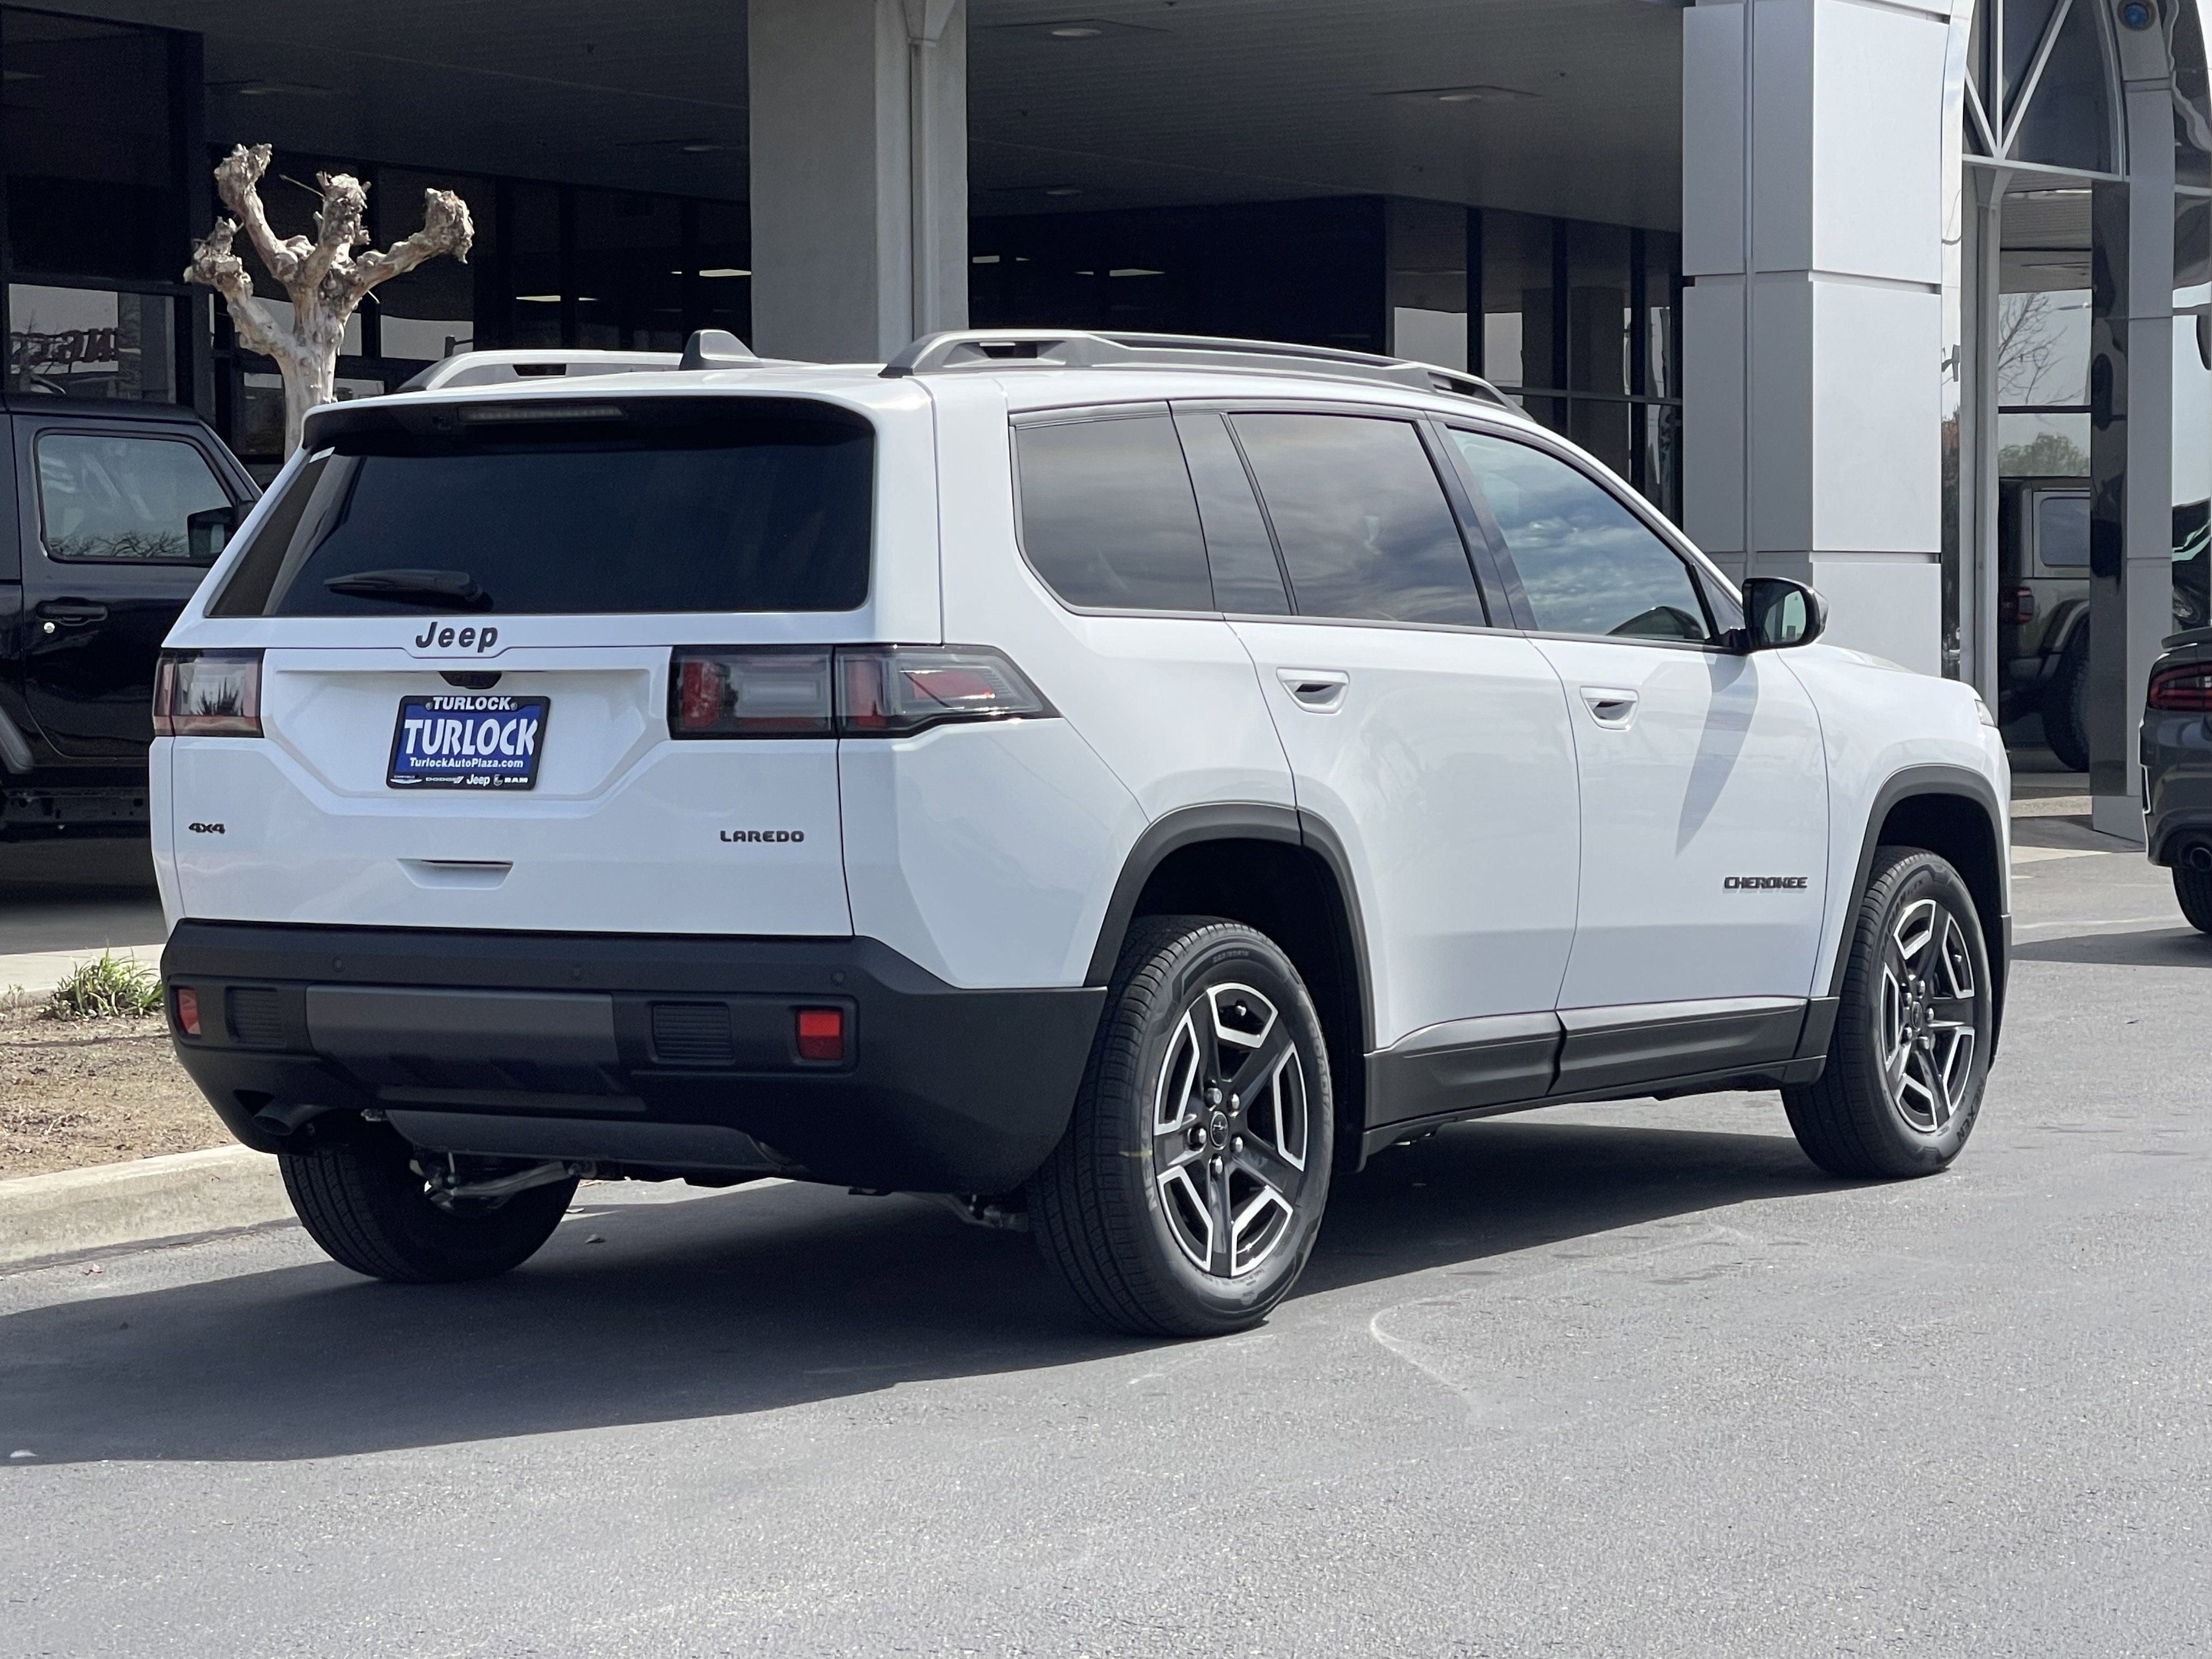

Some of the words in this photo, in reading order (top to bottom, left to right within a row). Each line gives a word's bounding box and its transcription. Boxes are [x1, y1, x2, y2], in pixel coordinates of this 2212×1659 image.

[415, 621, 499, 653] Jeep
[433, 697, 512, 710] TURLOCK
[404, 718, 539, 756] TURLOCK
[410, 757, 523, 768] TurlockAutoPlaza.com
[467, 774, 490, 786] Jeep
[720, 830, 805, 843] LAREDO
[1724, 876, 1808, 889] CHEROKEE
[1141, 1094, 1158, 1211] NEXEN
